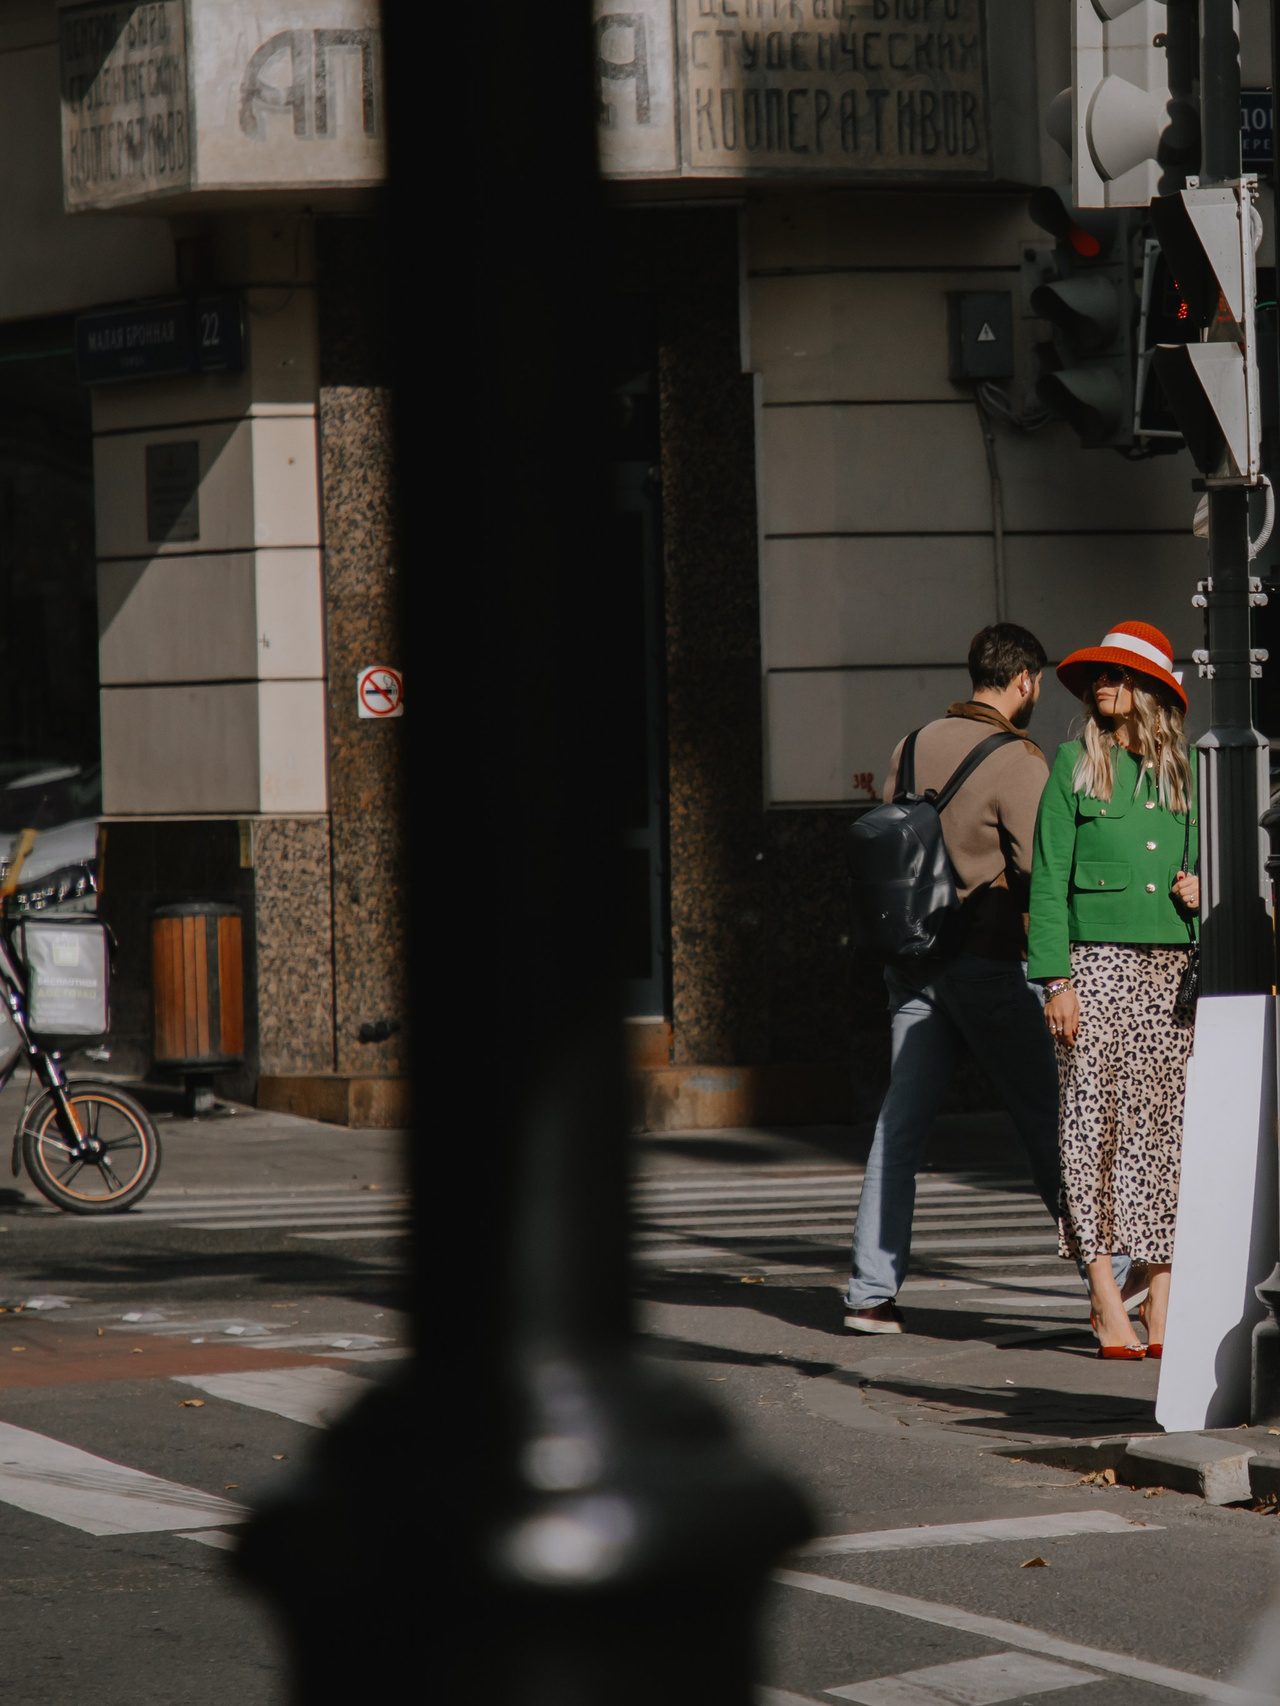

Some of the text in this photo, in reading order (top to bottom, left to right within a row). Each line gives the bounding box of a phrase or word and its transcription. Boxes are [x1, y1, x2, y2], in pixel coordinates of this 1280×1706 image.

[694, 87, 980, 155] КООПЕРАТИВОВ
[88, 319, 175, 353] МАЛАЯ БРОННАЯ
[201, 312, 220, 347] 22
